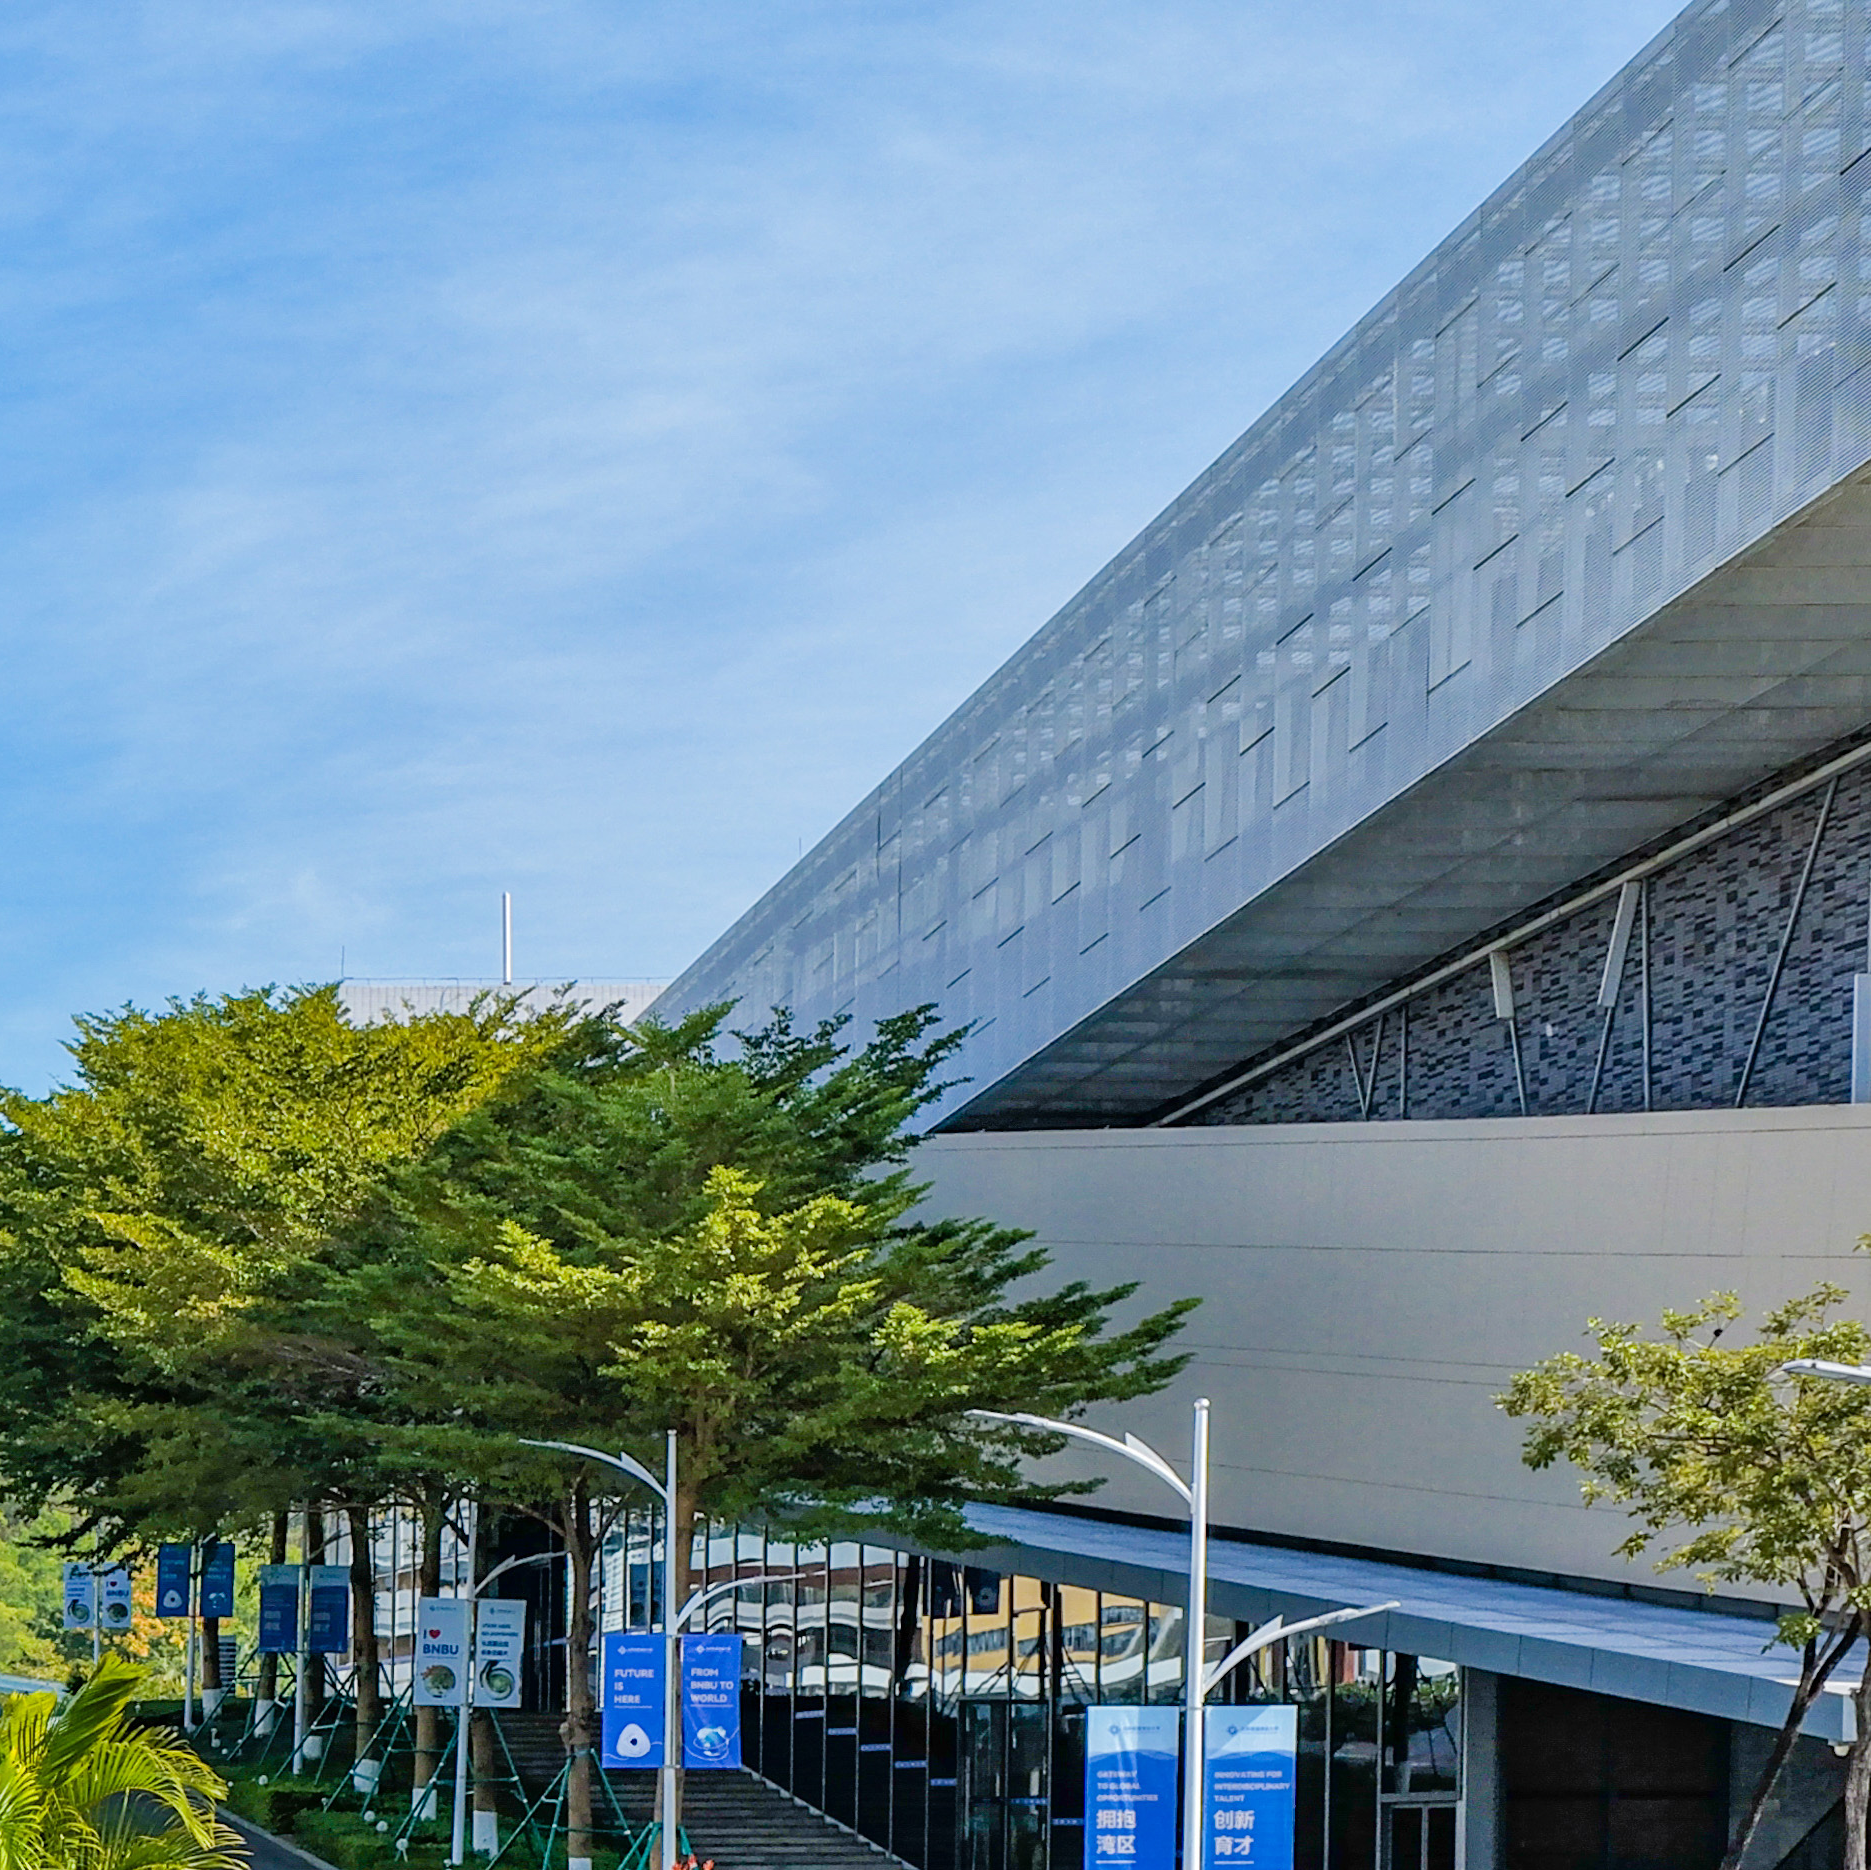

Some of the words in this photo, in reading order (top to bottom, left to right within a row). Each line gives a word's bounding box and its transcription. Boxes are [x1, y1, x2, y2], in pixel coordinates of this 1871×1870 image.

[422, 1643, 459, 1655] BNBU
[614, 1668, 655, 1678] FUTURE
[690, 1667, 719, 1677] FROM
[614, 1681, 624, 1691] IS
[690, 1681, 718, 1690] BNBU
[720, 1681, 734, 1690] TO
[614, 1694, 641, 1704] HERE
[690, 1694, 728, 1703] WORLD
[1266, 1770, 1283, 1778] FOR
[1214, 1794, 1245, 1802] TALENT
[1096, 1809, 1137, 1829] 拥抱
[1213, 1809, 1255, 1830] 创新
[1096, 1834, 1137, 1855] 湾区
[1214, 1835, 1255, 1856] 育才
